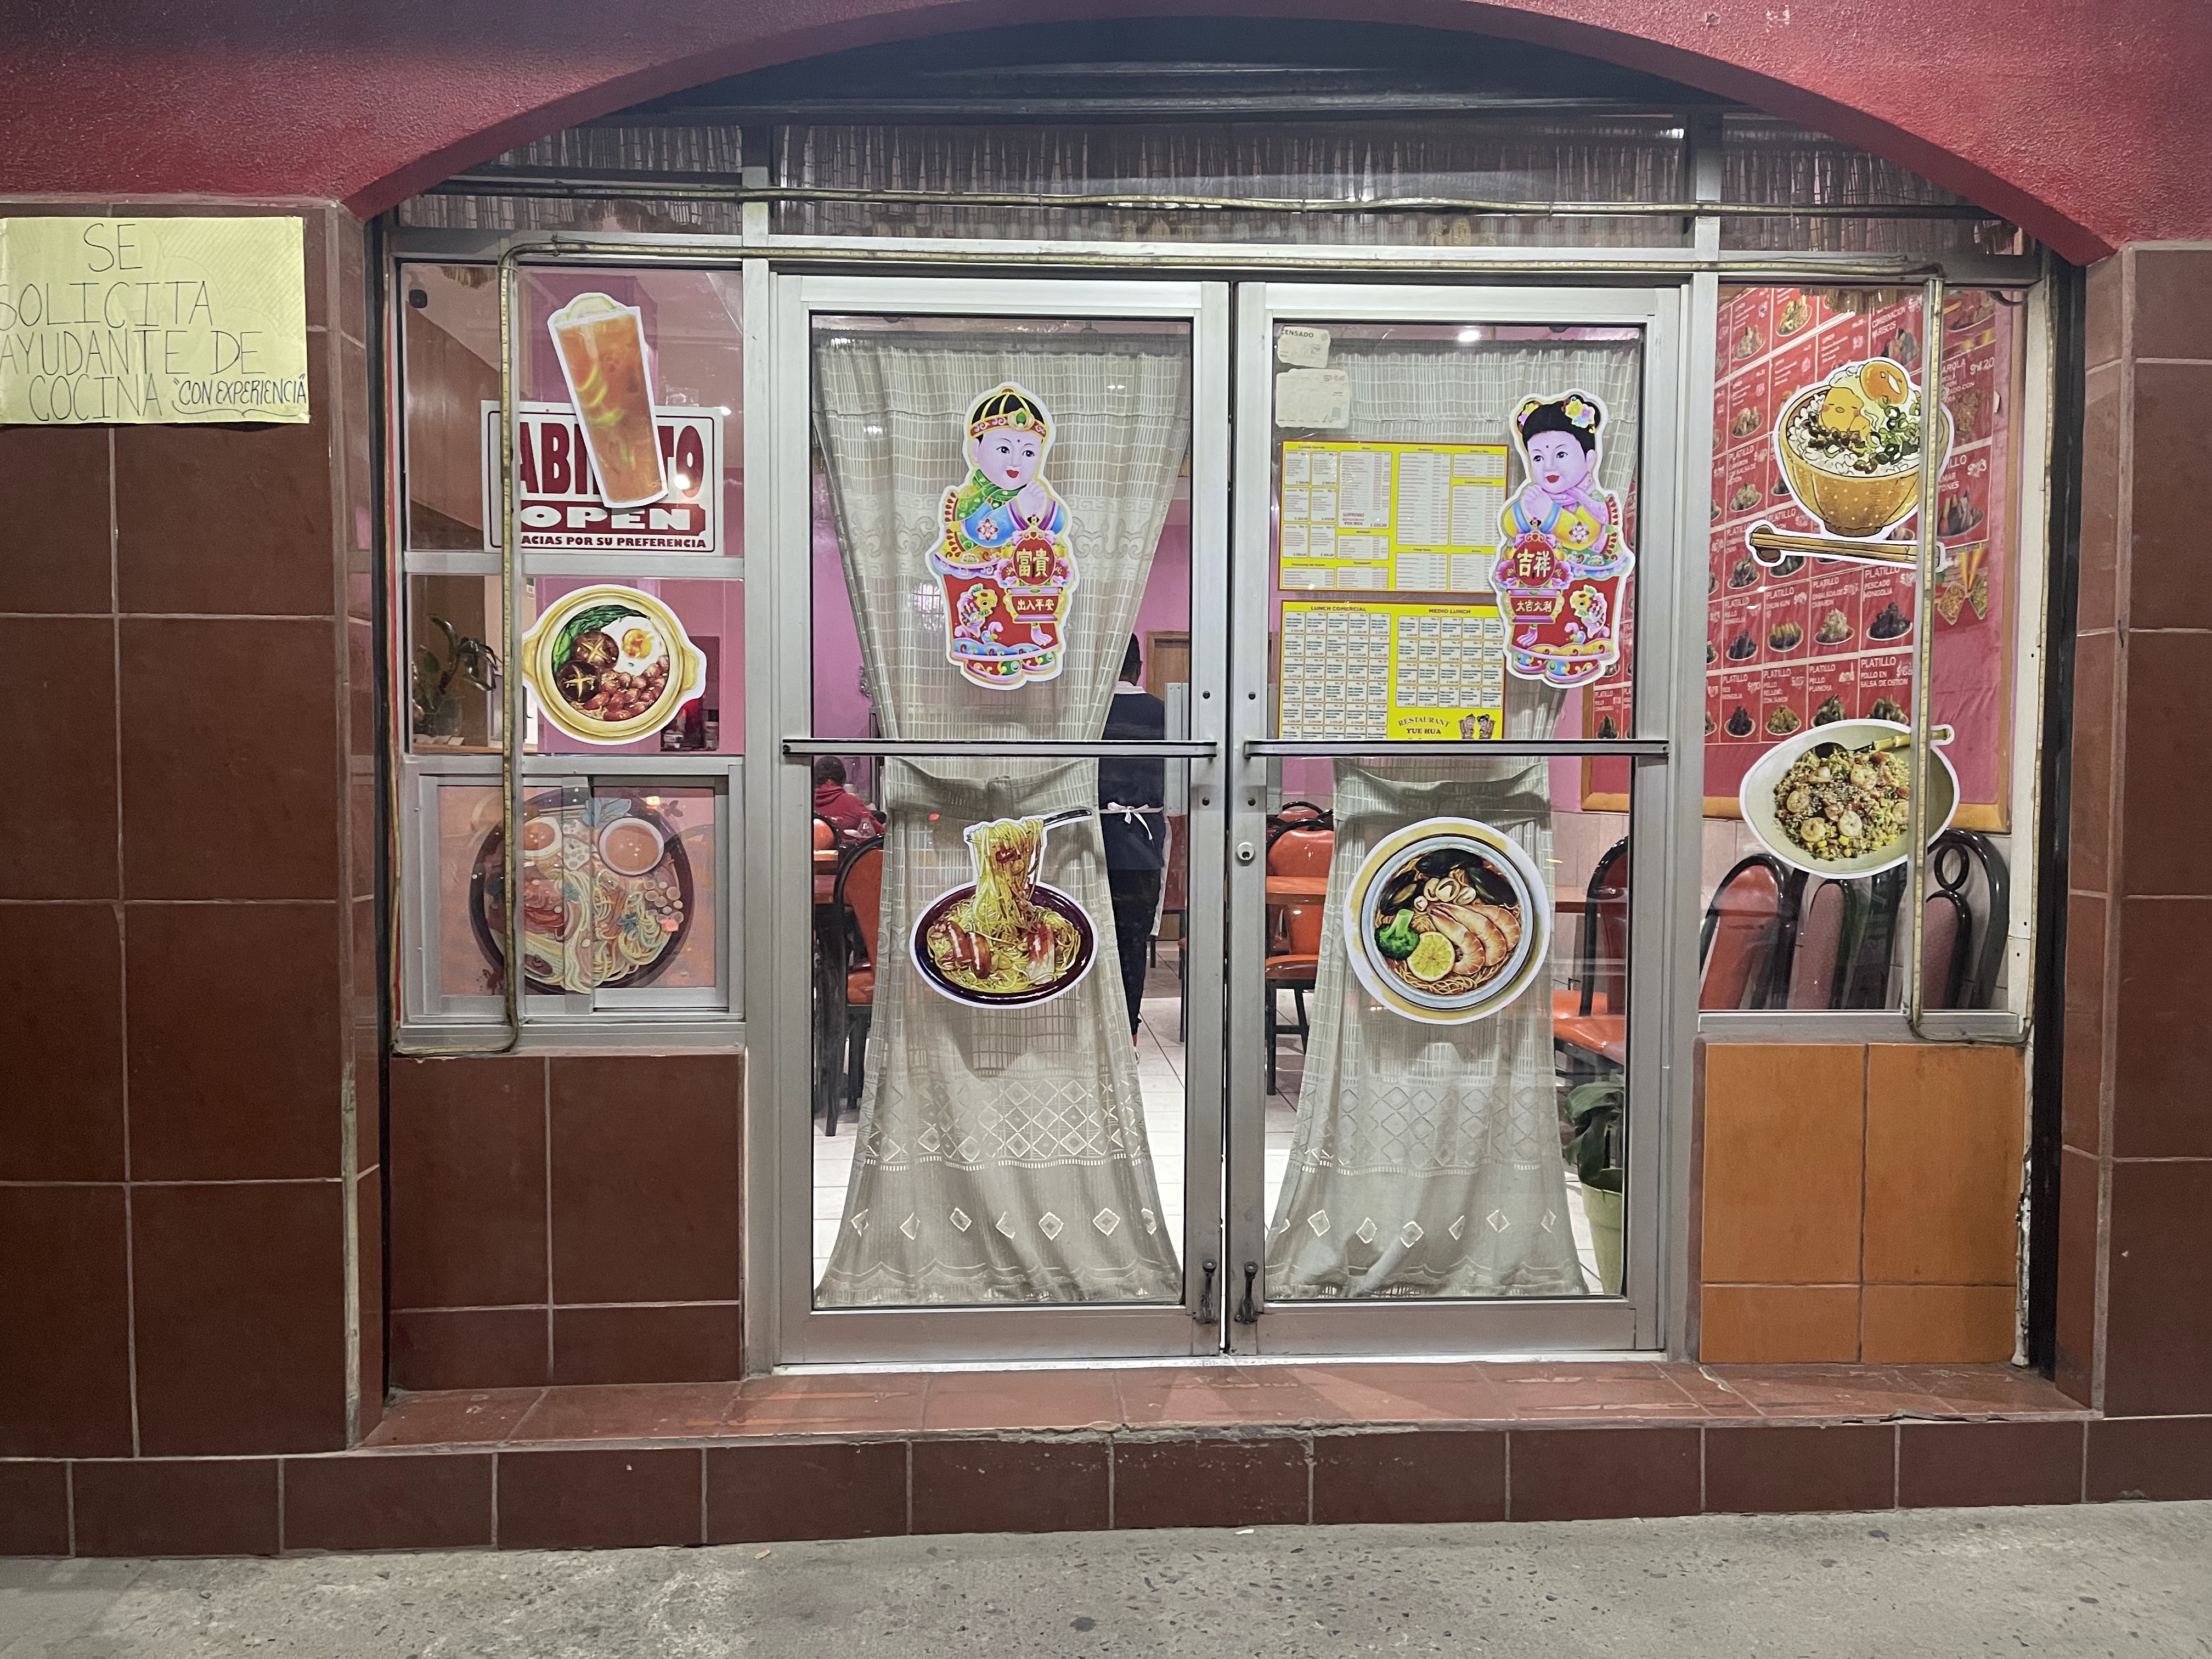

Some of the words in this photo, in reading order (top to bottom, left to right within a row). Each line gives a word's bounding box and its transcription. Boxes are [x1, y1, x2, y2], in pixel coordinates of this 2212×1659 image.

[83, 223, 143, 272] SE
[0, 280, 213, 331] SOLICITA
[0, 328, 190, 376] AYUDANTE
[210, 330, 266, 375] DE
[29, 373, 163, 422] COCINA
[521, 505, 691, 531] OPEN
[1768, 508, 1796, 523] PLATILLO
[522, 535, 562, 545] ACIAS
[567, 537, 594, 546] POR
[597, 537, 613, 546] SU
[617, 538, 706, 548] PREFERENCIA
[1017, 548, 1051, 577] 富貴
[1517, 549, 1551, 577] 吉祥
[1865, 566, 1900, 578] PLATILLO
[1813, 577, 1839, 588] PLATILLO
[1864, 579, 1891, 590] PESCADO
[1765, 586, 1795, 600] PLATILLO
[1017, 599, 1054, 612] 出入平安
[1516, 600, 1553, 613] 大吉大利
[1725, 597, 1750, 609] PLATILLO
[1809, 664, 1836, 673] PLATILLO
[1861, 656, 1896, 668] PLATILLO
[1723, 674, 1748, 684] PLATILLO
[1763, 668, 1791, 678] PLATILLO
[1398, 716, 1450, 727] RESTAURANT
